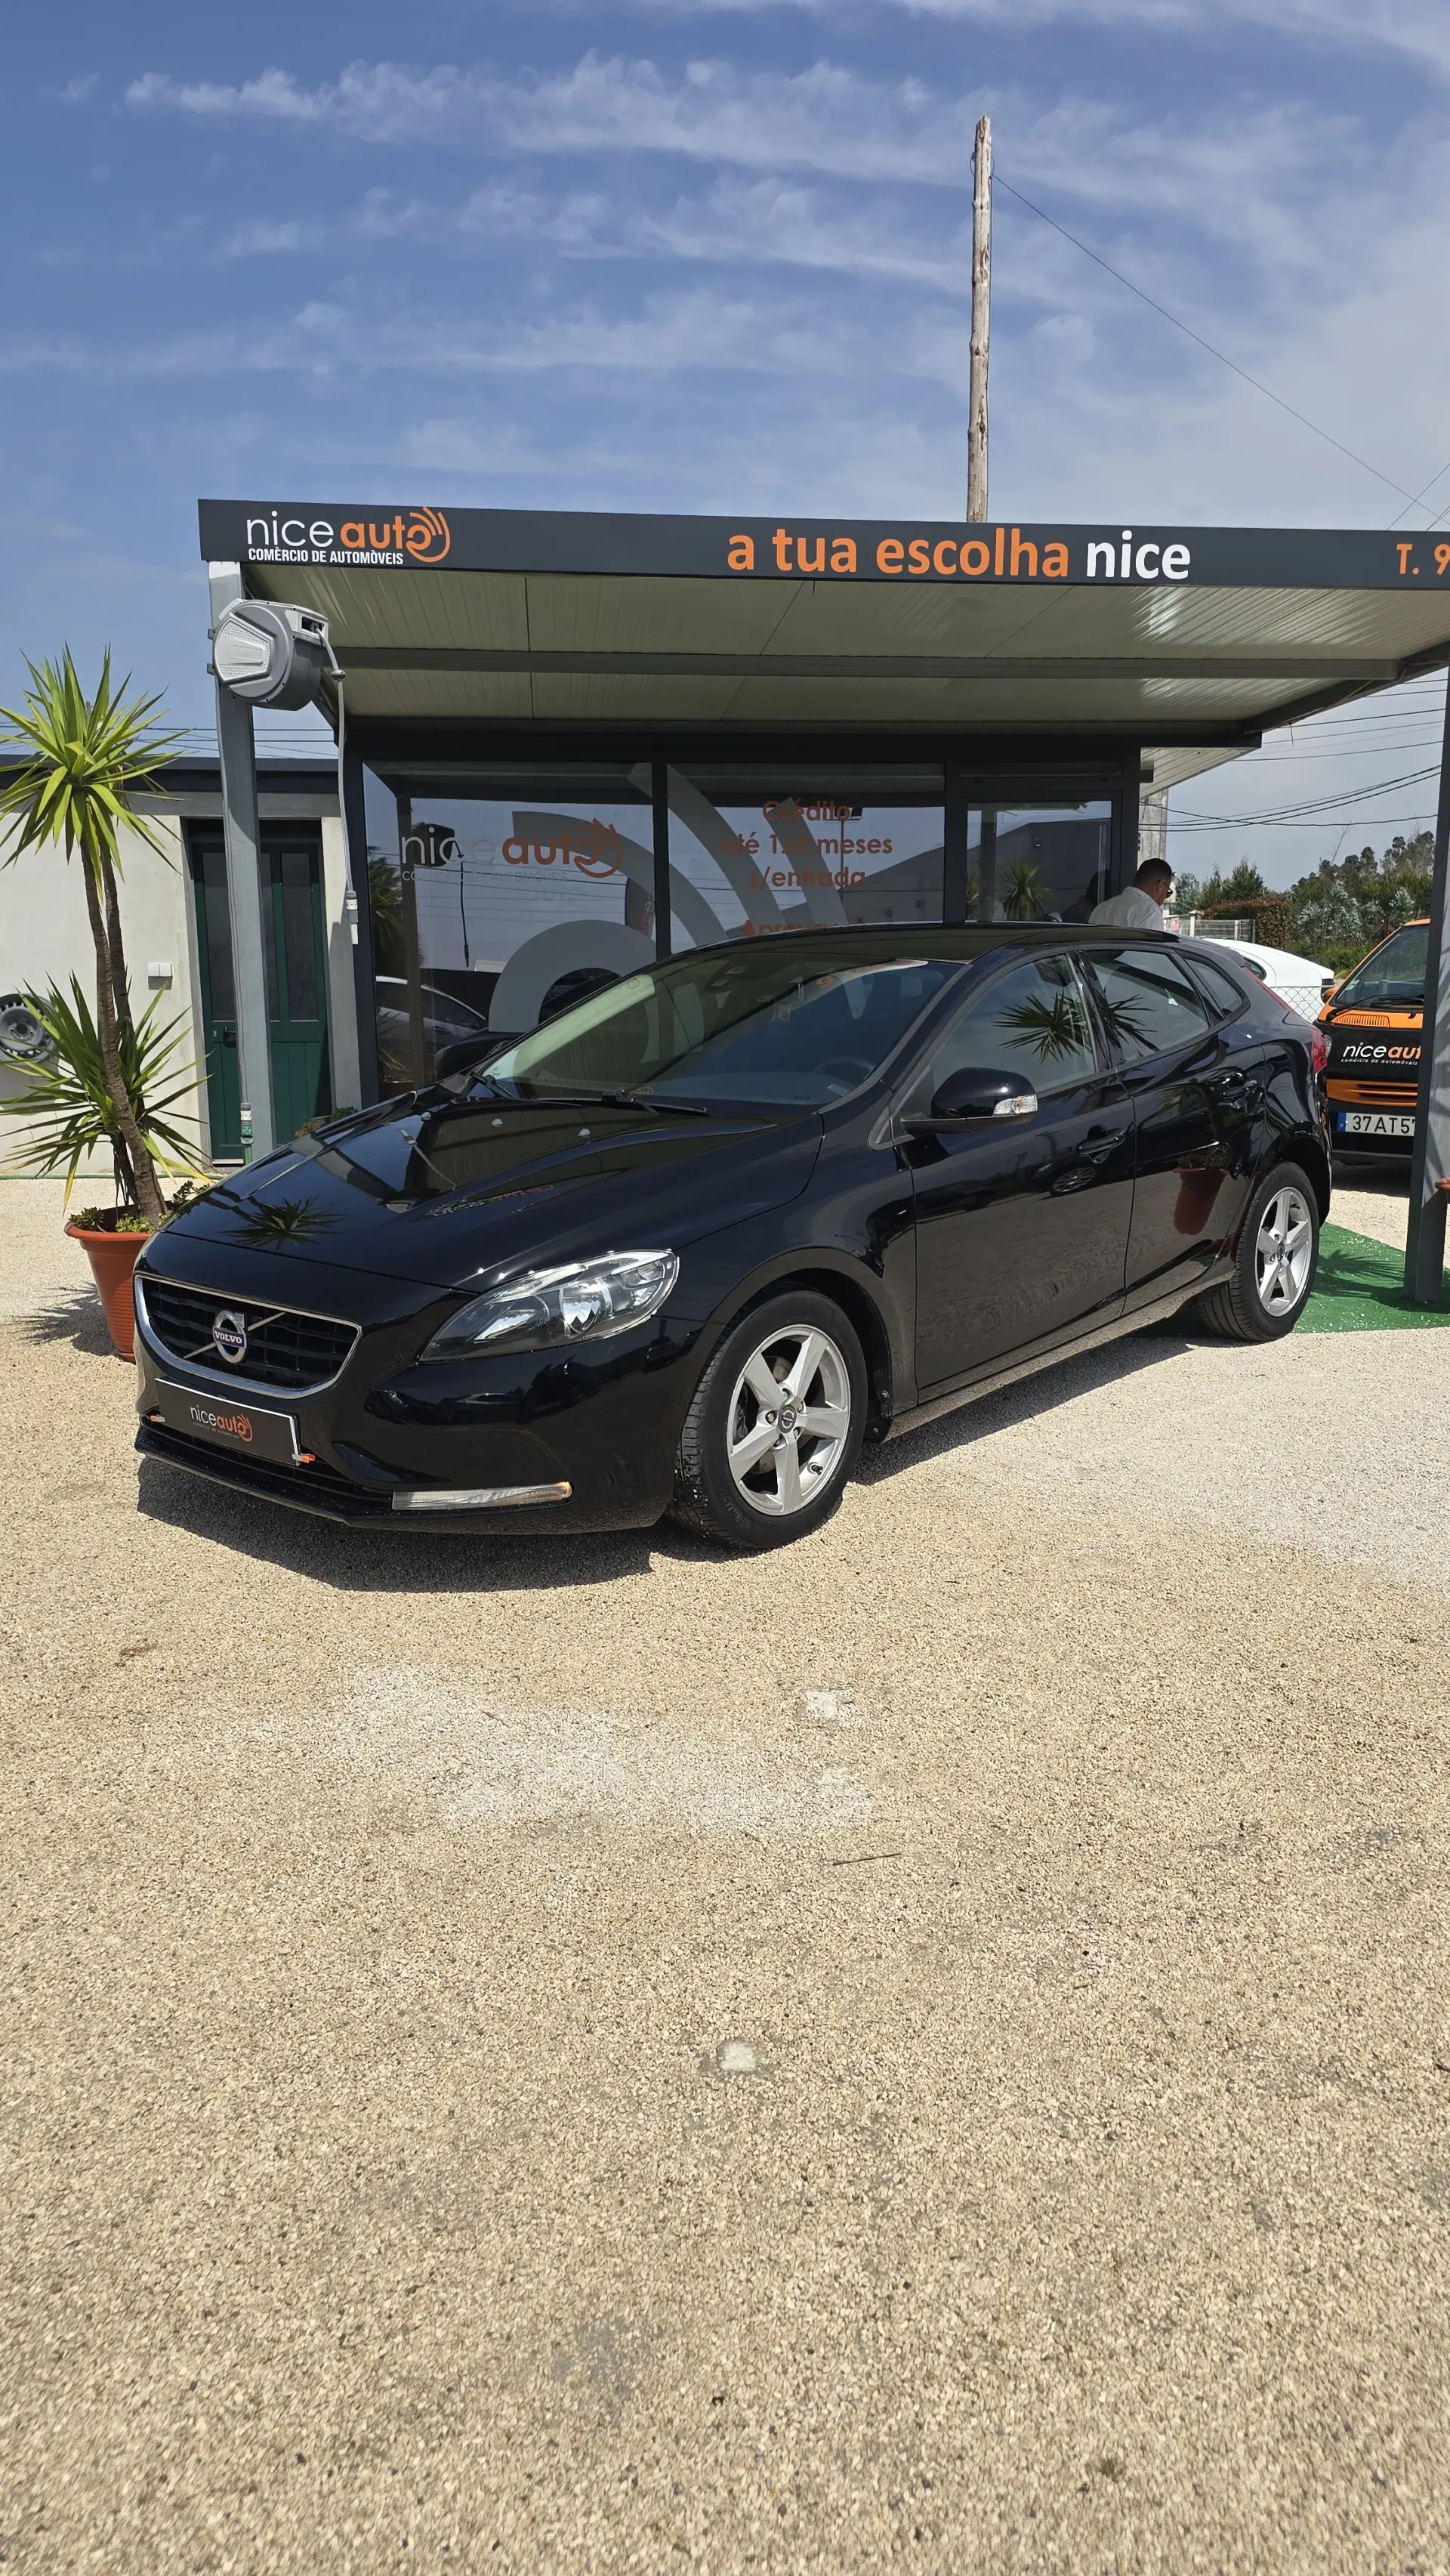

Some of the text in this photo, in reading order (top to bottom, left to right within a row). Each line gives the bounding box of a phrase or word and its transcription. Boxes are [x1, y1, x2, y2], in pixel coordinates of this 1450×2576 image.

[312, 549, 327, 563] DE
[727, 528, 1191, 580] a tua escolha nice
[1396, 543, 1420, 575] T.
[762, 798, 852, 822] Crédito
[721, 832, 760, 854] até
[817, 837, 893, 855] meses
[1353, 1115, 1416, 1134] 37AT5
[214, 1330, 242, 1345] VOLVO
